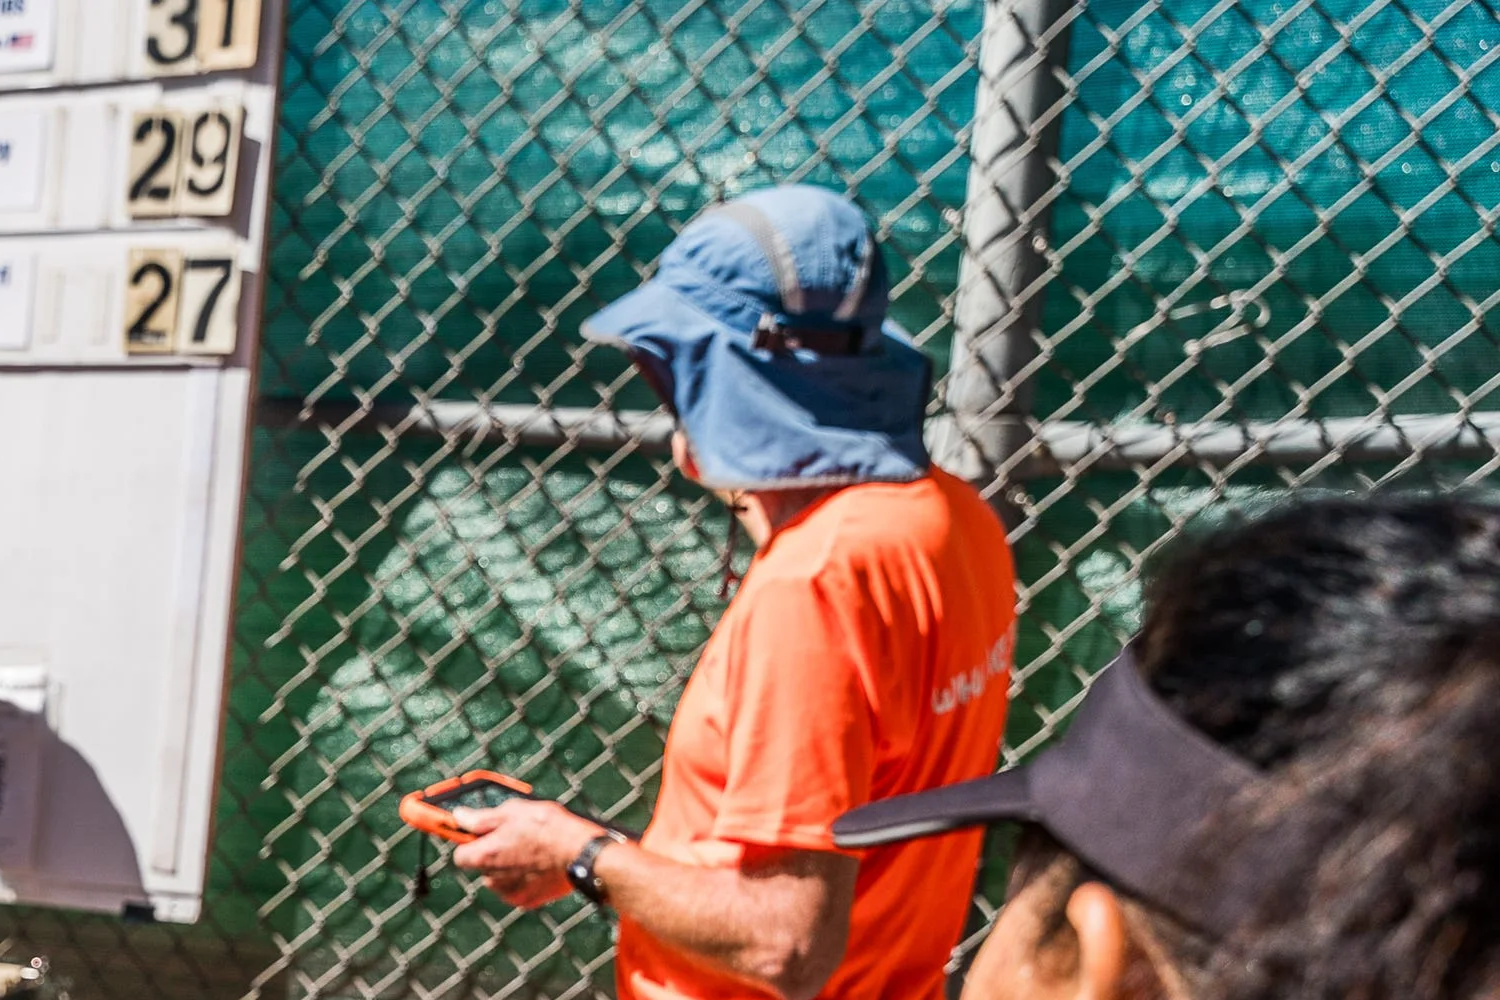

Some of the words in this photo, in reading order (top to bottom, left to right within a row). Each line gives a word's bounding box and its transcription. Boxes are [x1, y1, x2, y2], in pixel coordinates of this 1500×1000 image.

[147, 0, 235, 65] 31
[129, 112, 232, 200] 29
[128, 259, 232, 343] 27
